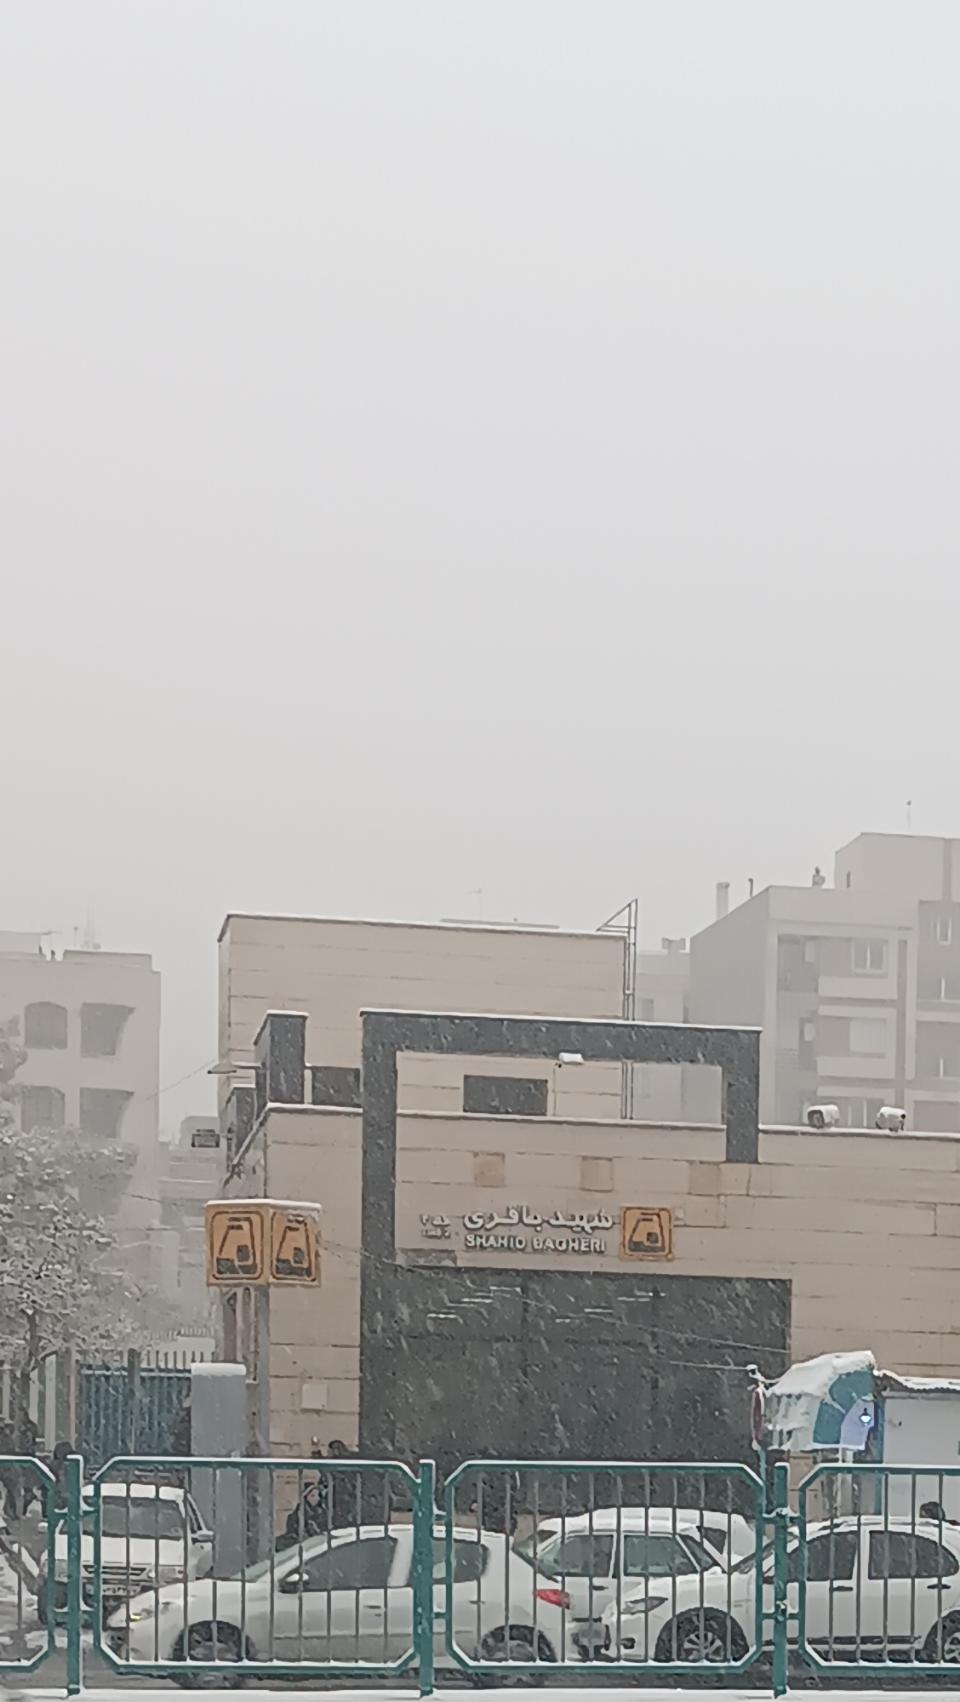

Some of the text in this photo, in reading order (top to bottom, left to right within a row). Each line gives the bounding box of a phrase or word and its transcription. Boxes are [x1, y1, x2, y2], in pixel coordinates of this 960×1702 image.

[464, 1205, 613, 1232] شهید باقری
[464, 1233, 527, 1250] SHAHID
[532, 1236, 607, 1253] BAGHERI
